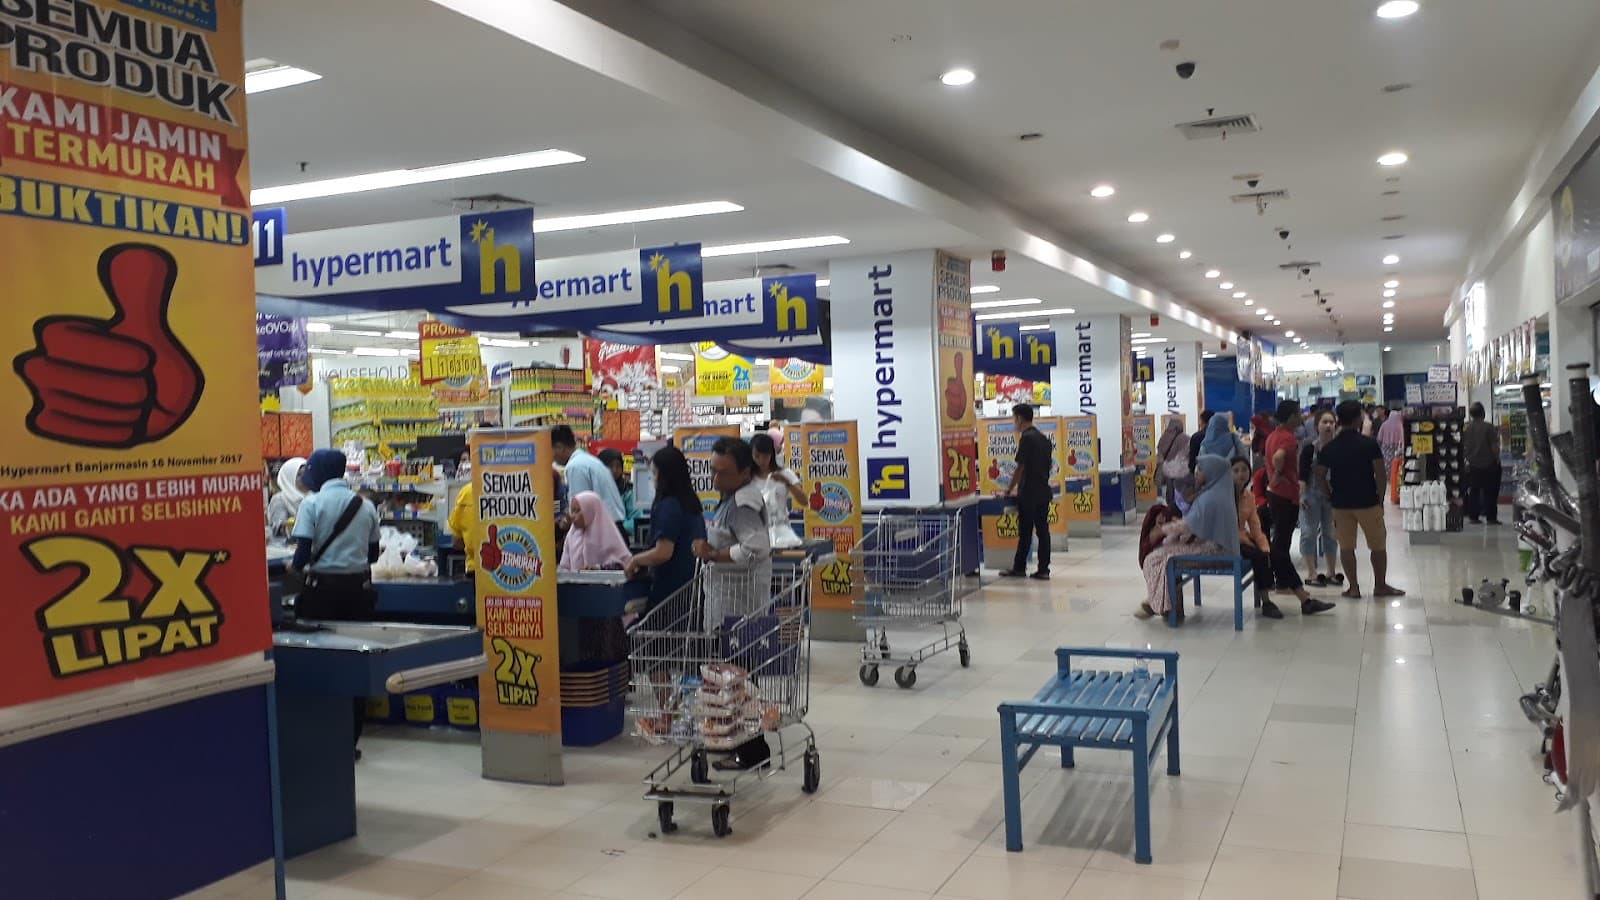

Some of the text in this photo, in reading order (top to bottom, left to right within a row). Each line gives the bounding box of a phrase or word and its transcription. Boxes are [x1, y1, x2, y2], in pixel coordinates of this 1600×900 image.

[0, 86, 220, 161] KAMI JAMIN
[7, 122, 215, 190] TERMURAH
[0, 176, 243, 244] BUKTIKAN!
[252, 219, 275, 258] 11
[292, 237, 451, 287] hypermart
[527, 268, 632, 302] ermart
[868, 264, 902, 448] hypermart
[1075, 321, 1097, 415] ypermart
[1164, 347, 1179, 414] ypermart
[0, 463, 71, 479] Hypermart
[75, 458, 149, 474] Banjarmasin
[167, 455, 218, 467] November
[219, 454, 243, 464] 2017
[687, 460, 713, 475] SEM
[809, 464, 848, 479] PRODUK
[811, 448, 845, 462] SEMUA
[33, 487, 77, 509] ADA
[84, 482, 139, 504] YANG
[145, 479, 196, 499] LEBIH
[202, 474, 262, 494] MURAH
[483, 472, 531, 494] SEMUA
[11, 496, 242, 535] KAMI GANTI SELISIHNYA
[480, 496, 537, 520] PRODUK
[487, 608, 541, 623] KAMI GANTI
[487, 622, 541, 638] SELISIHNYA
[51, 615, 218, 675] LIPAT
[498, 683, 537, 705] LIPAT
